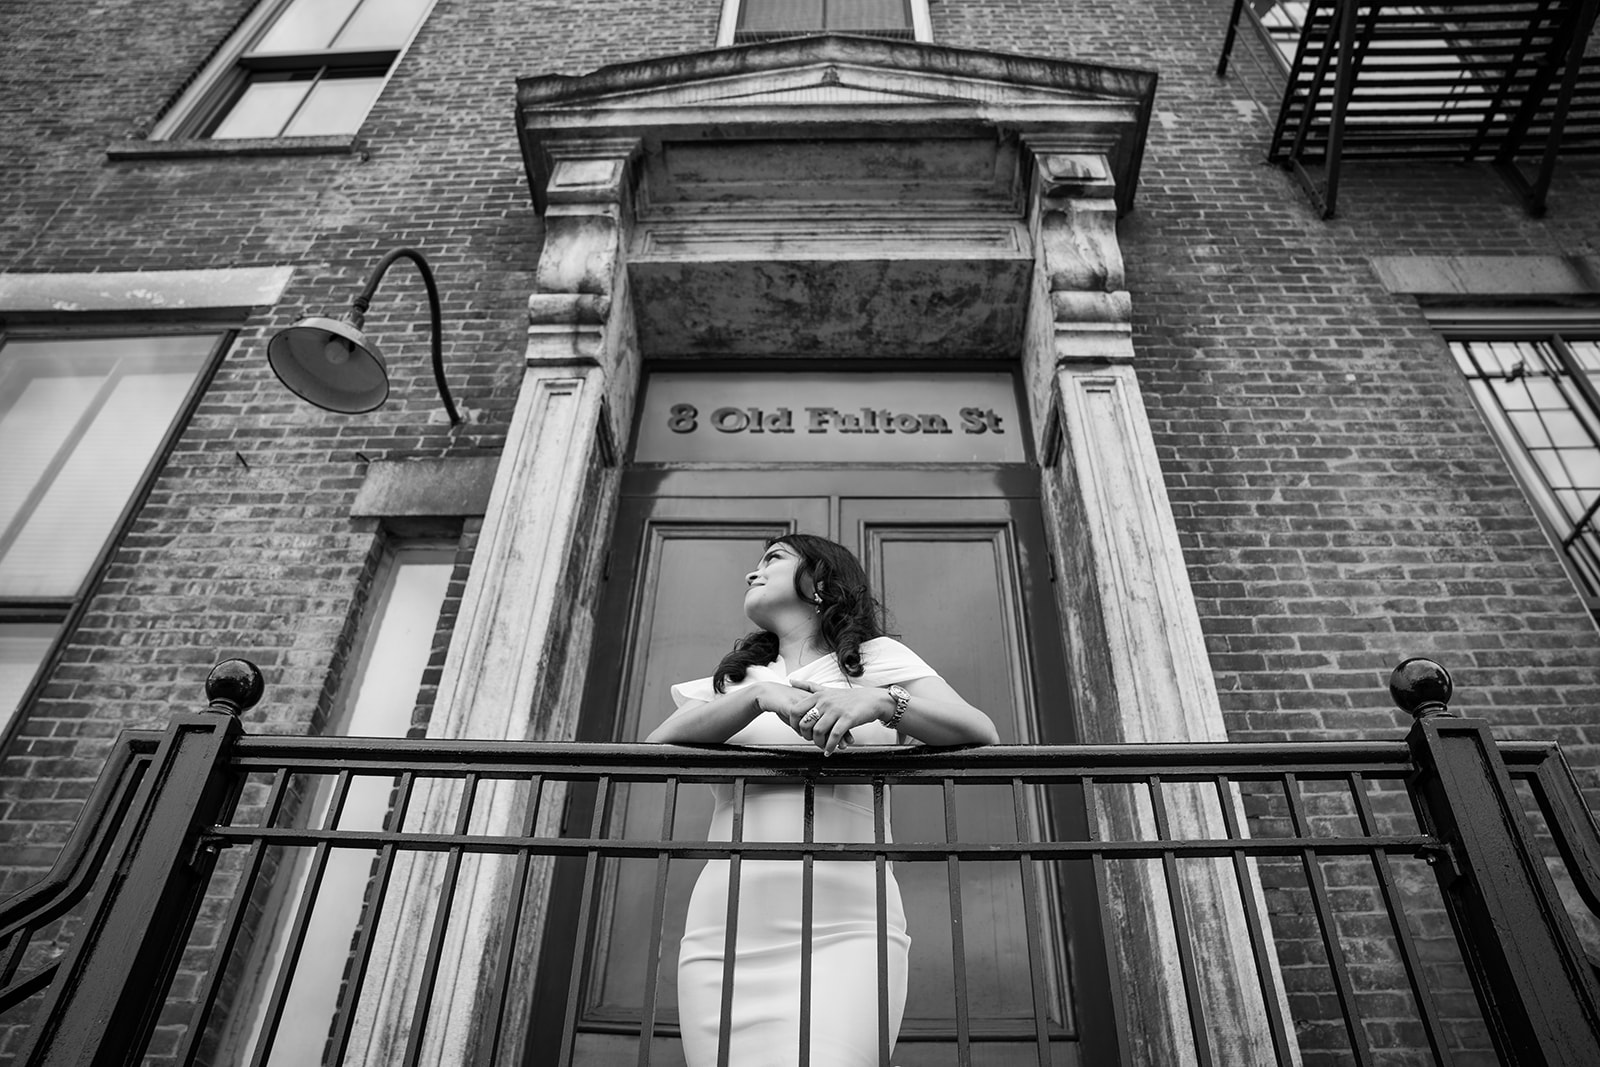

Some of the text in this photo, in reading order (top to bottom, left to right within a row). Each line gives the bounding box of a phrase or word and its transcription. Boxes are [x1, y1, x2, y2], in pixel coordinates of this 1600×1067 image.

[668, 403, 1004, 434] 8 Old Fulton St
